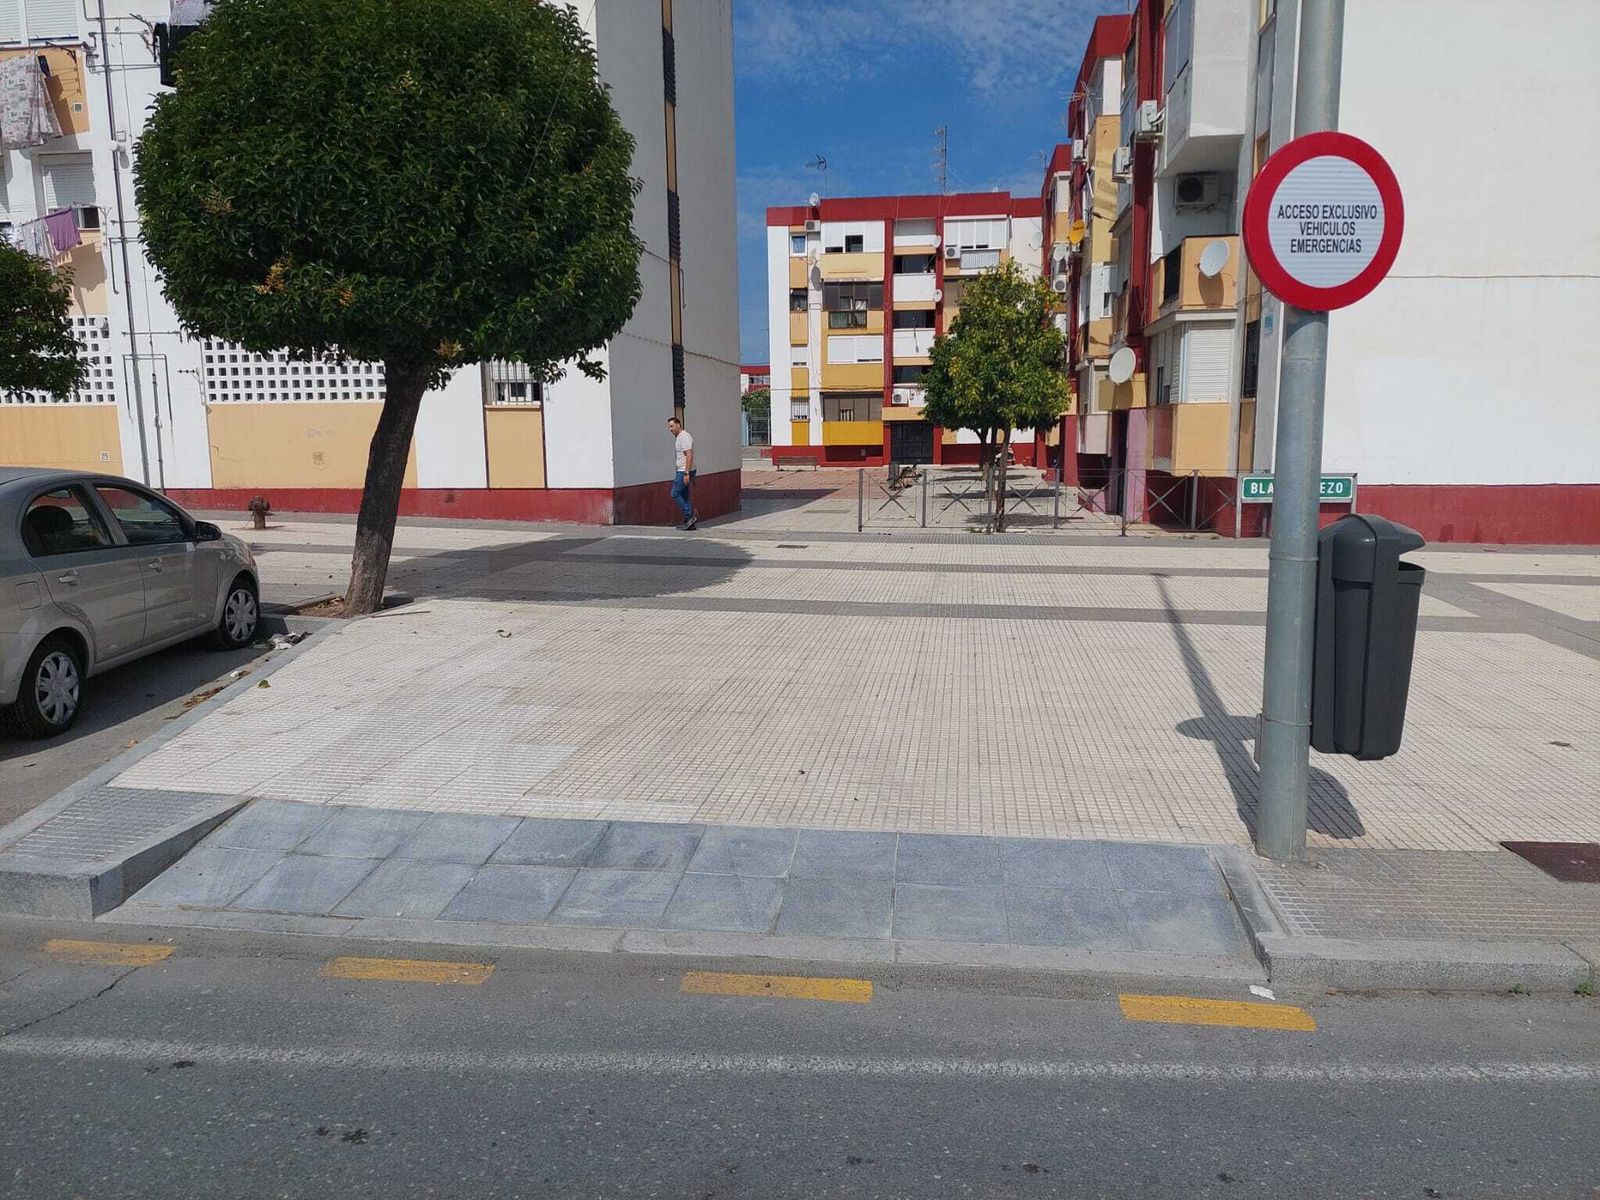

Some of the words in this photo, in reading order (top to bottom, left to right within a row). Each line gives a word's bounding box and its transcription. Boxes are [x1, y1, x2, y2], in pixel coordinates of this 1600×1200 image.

[1277, 205, 1320, 219] ACCESO
[1322, 205, 1378, 219] EXCLUSIVO
[1300, 222, 1356, 236] VEHICULOS
[1290, 239, 1361, 253] EMERGENCIAS
[1250, 482, 1274, 494] BLA
[1320, 482, 1344, 494] EZO
